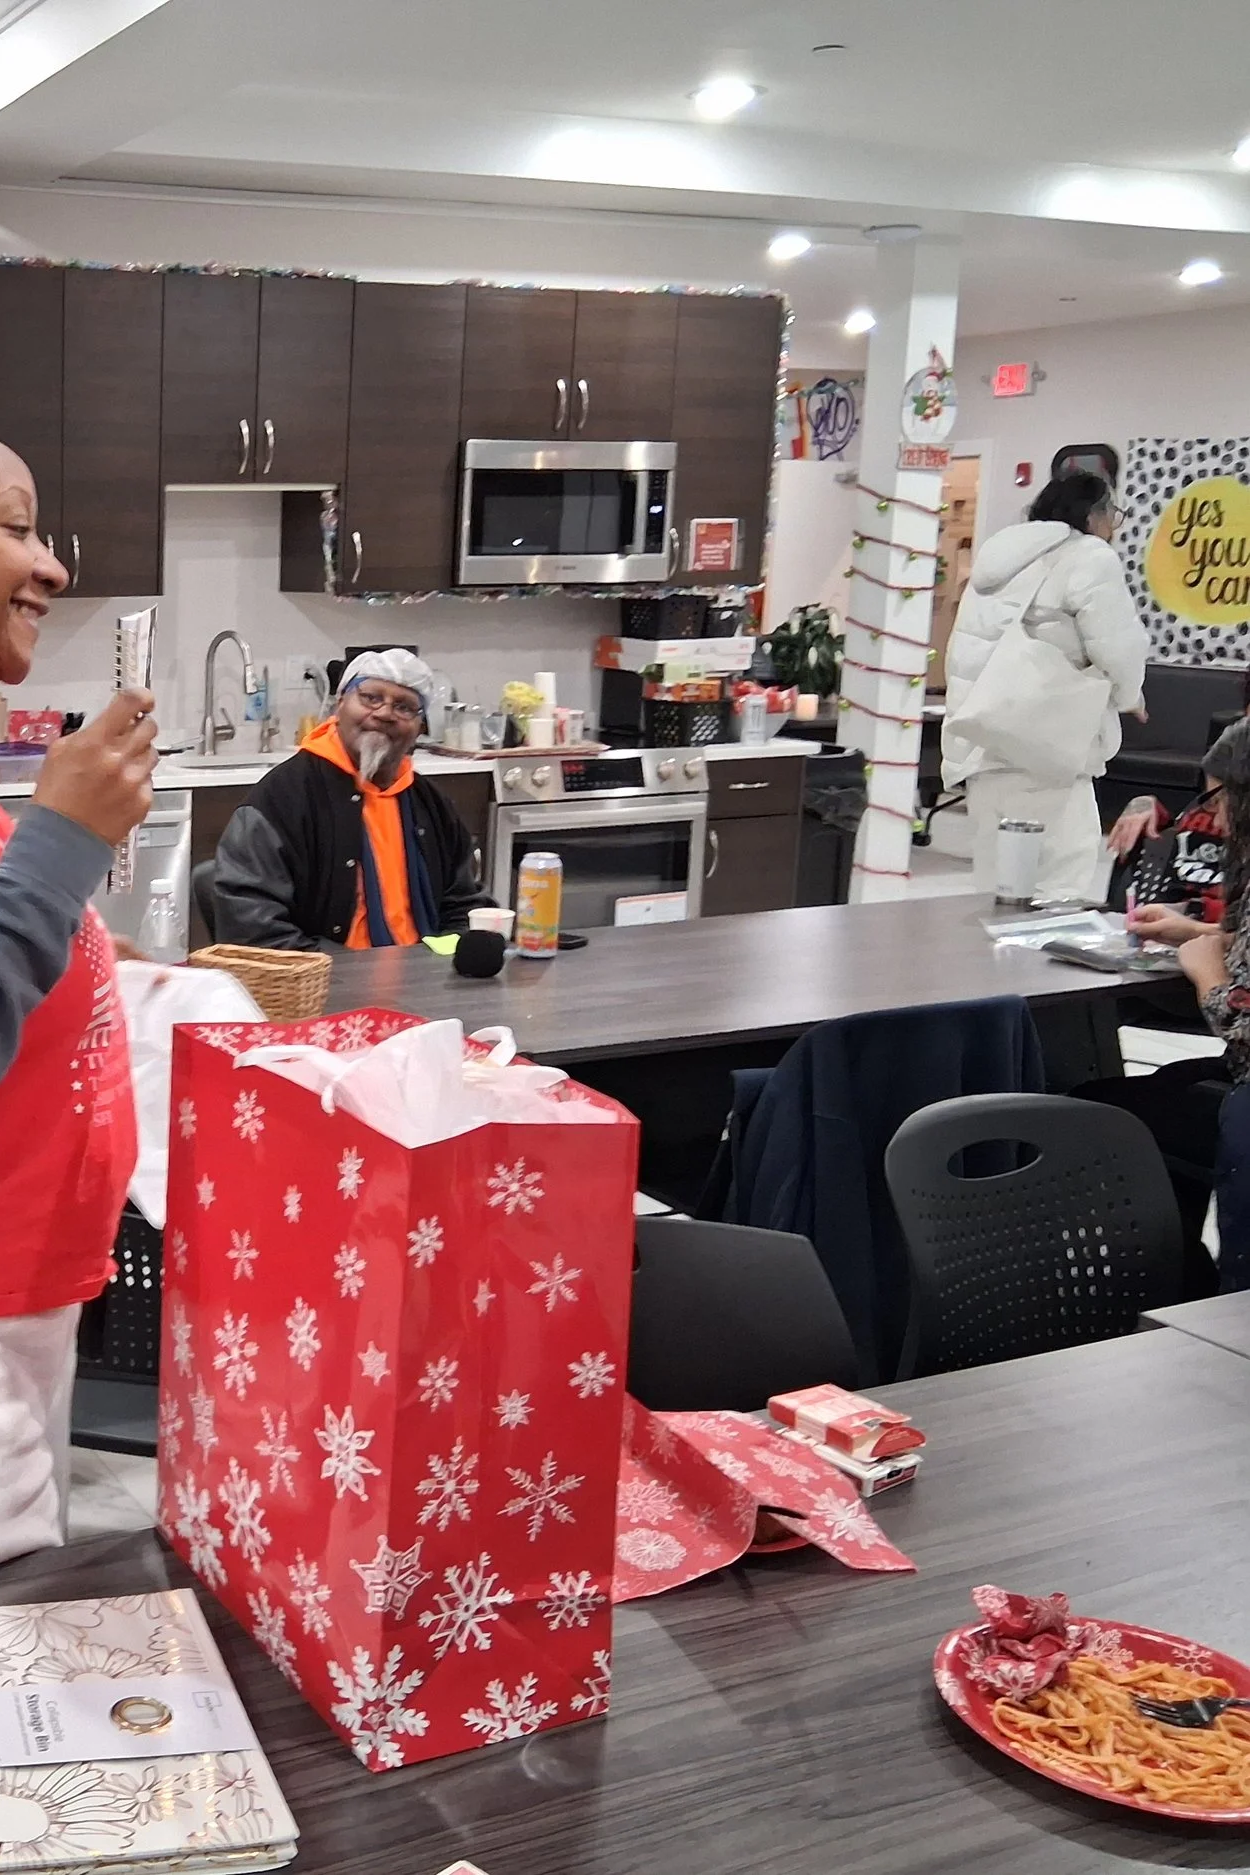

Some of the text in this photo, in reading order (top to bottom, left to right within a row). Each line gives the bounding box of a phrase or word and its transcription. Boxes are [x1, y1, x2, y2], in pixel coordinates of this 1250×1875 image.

[1170, 497, 1225, 547] yes
[1182, 537, 1250, 588] you
[25, 1693, 52, 1753] Storage Bin
[45, 1700, 66, 1743] Collapsible
